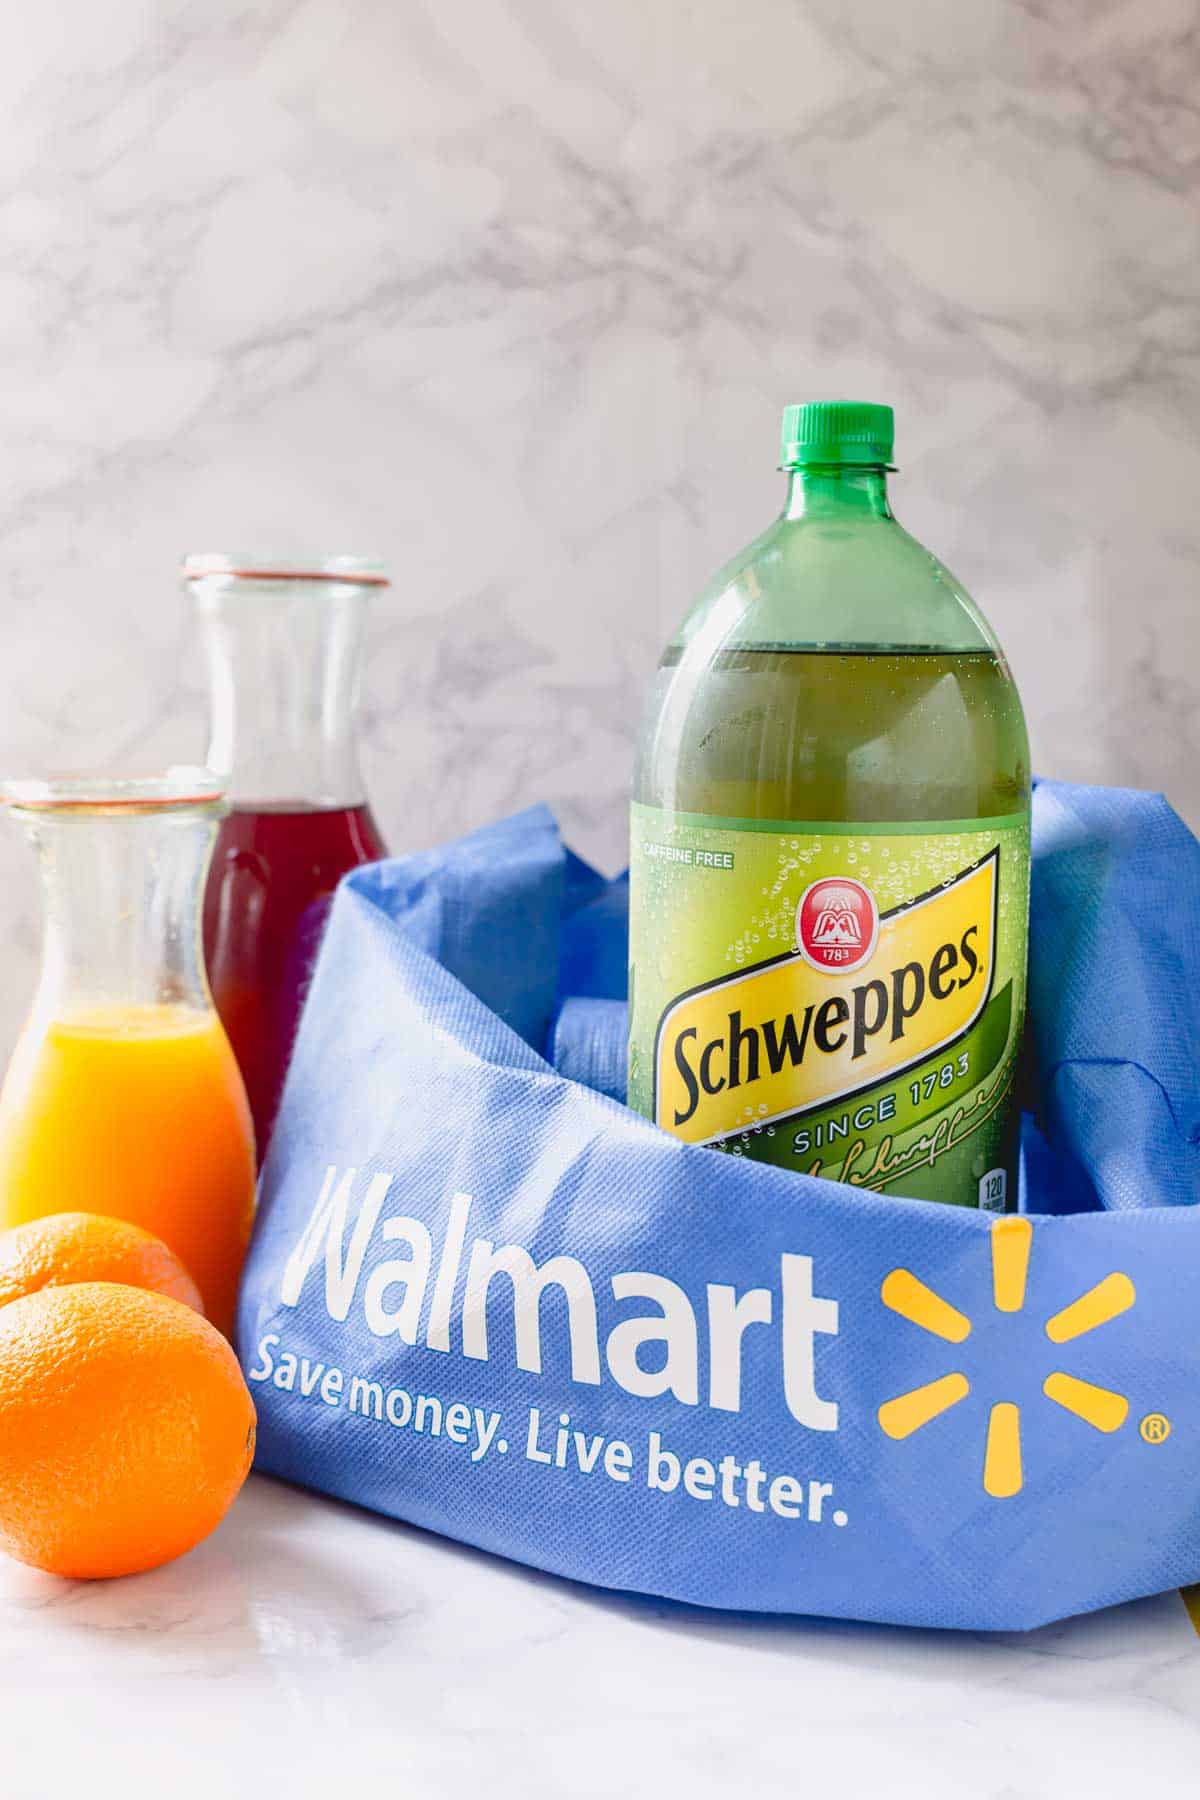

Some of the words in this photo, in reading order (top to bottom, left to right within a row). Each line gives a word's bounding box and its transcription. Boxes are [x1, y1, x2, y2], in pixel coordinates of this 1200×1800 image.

[643, 842, 693, 864] CAFFEINE
[695, 850, 733, 869] FREE
[823, 949, 849, 961] 1783
[792, 1095, 896, 1154] SINCE
[910, 1052, 969, 1105] 1783
[986, 1174, 1003, 1201] 120
[280, 1164, 839, 1432] Walmart
[249, 1333, 345, 1408] Save
[347, 1374, 509, 1462] money.
[525, 1406, 634, 1483] Live
[646, 1432, 850, 1528] better.
